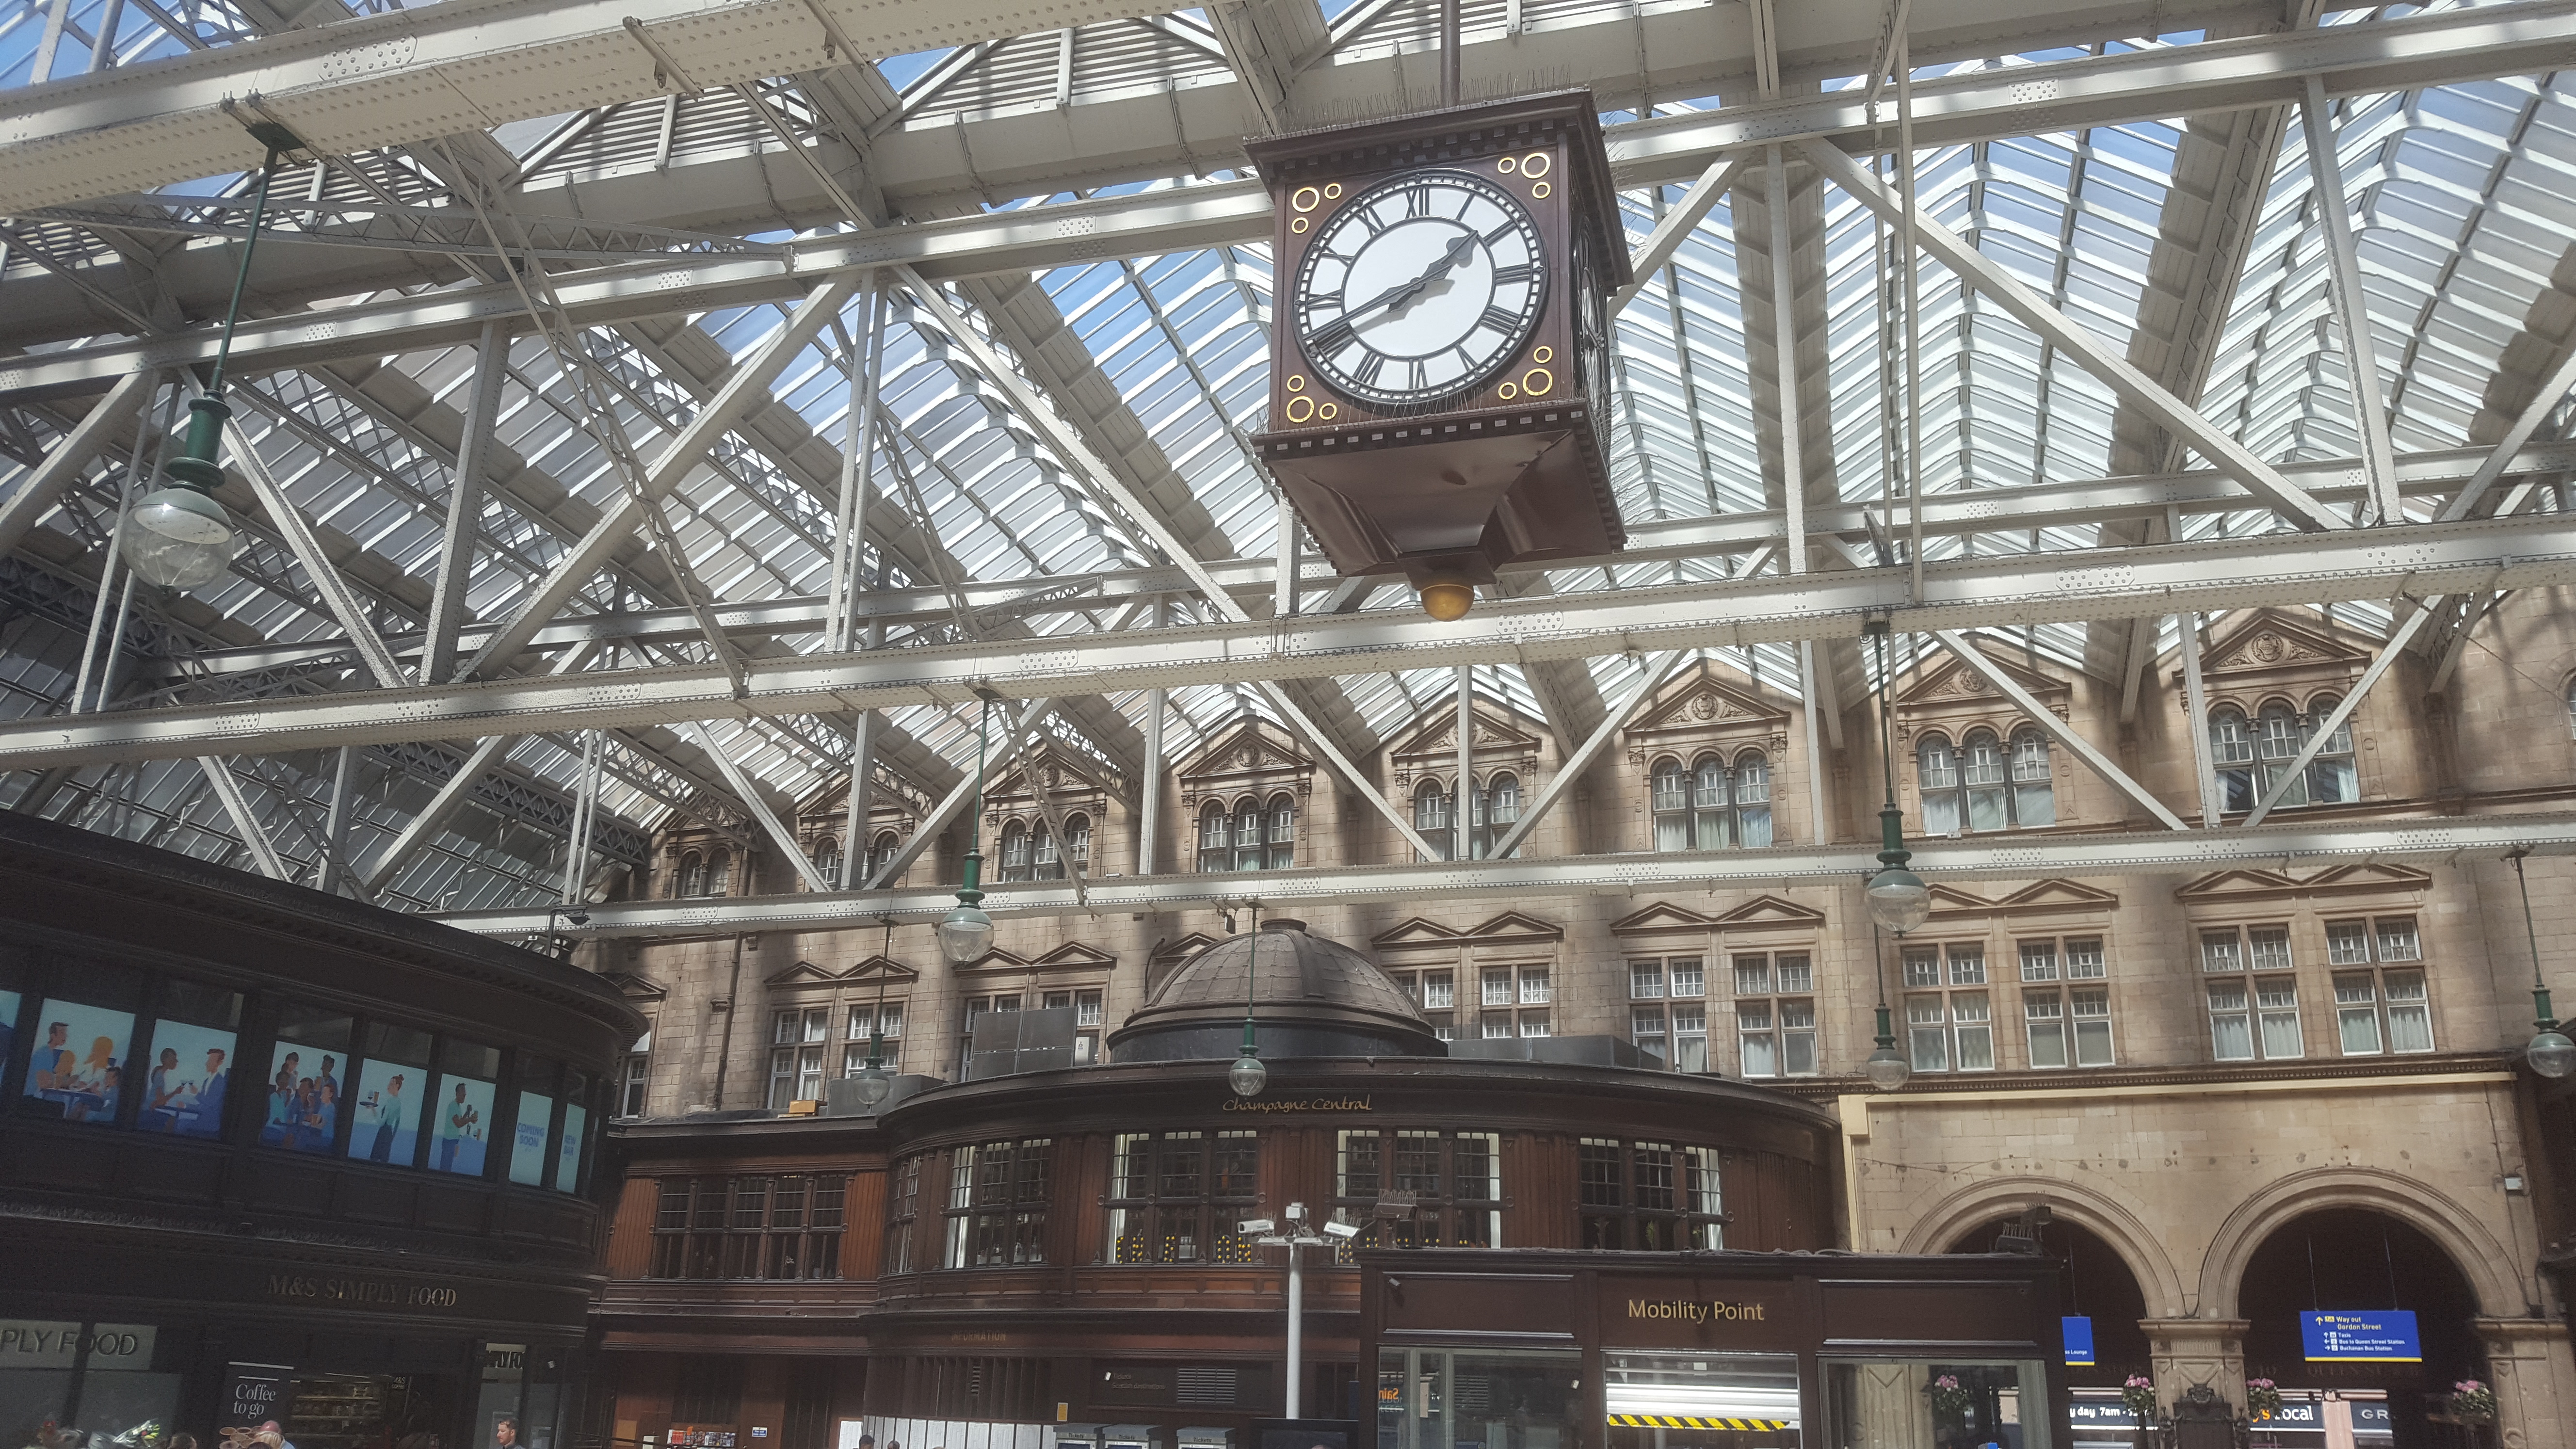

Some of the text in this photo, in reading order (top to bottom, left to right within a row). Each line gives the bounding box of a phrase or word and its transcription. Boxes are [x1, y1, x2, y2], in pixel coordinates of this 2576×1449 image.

[1404, 186, 1430, 219] XII
[1223, 1095, 1372, 1114] Champagne Central
[268, 1275, 457, 1307] M&S SIMPLY FOOD
[1628, 1299, 1765, 1324] Mobility Point
[951, 1330, 1006, 1341] INFORMATION
[235, 1383, 277, 1401] Coffee
[233, 1400, 265, 1419] to go
[2077, 1406, 2095, 1418] day
[2099, 1407, 2120, 1417] 7am
